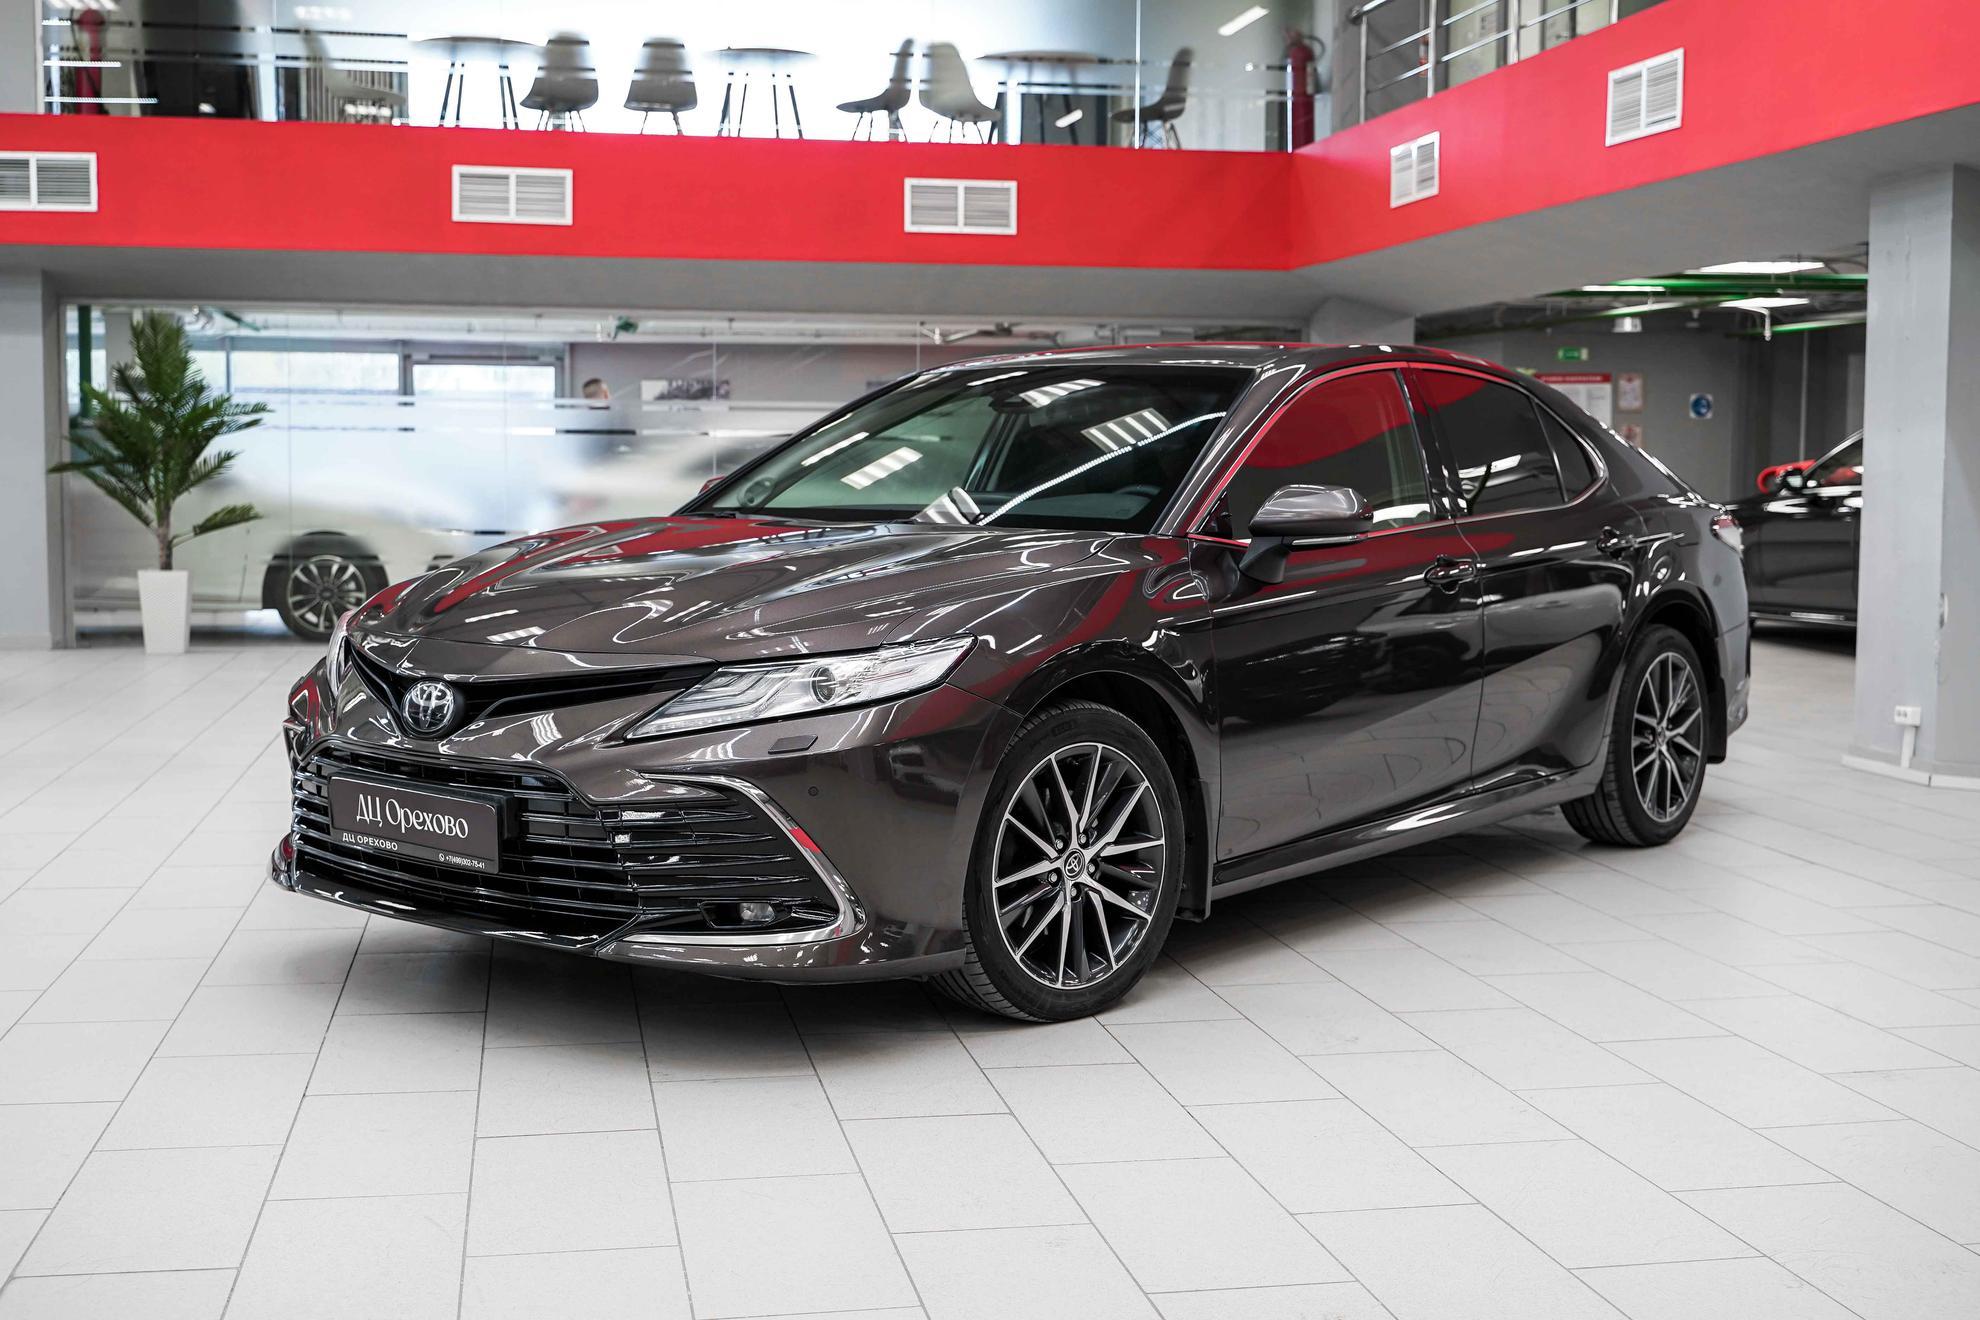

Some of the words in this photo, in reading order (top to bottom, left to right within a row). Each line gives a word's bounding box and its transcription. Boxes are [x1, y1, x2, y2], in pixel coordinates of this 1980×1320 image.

[356, 793, 383, 827] ДЦ
[385, 798, 469, 838] Орехово
[342, 832, 356, 844] ДЦ
[356, 835, 398, 851] ОРЕХОВО
